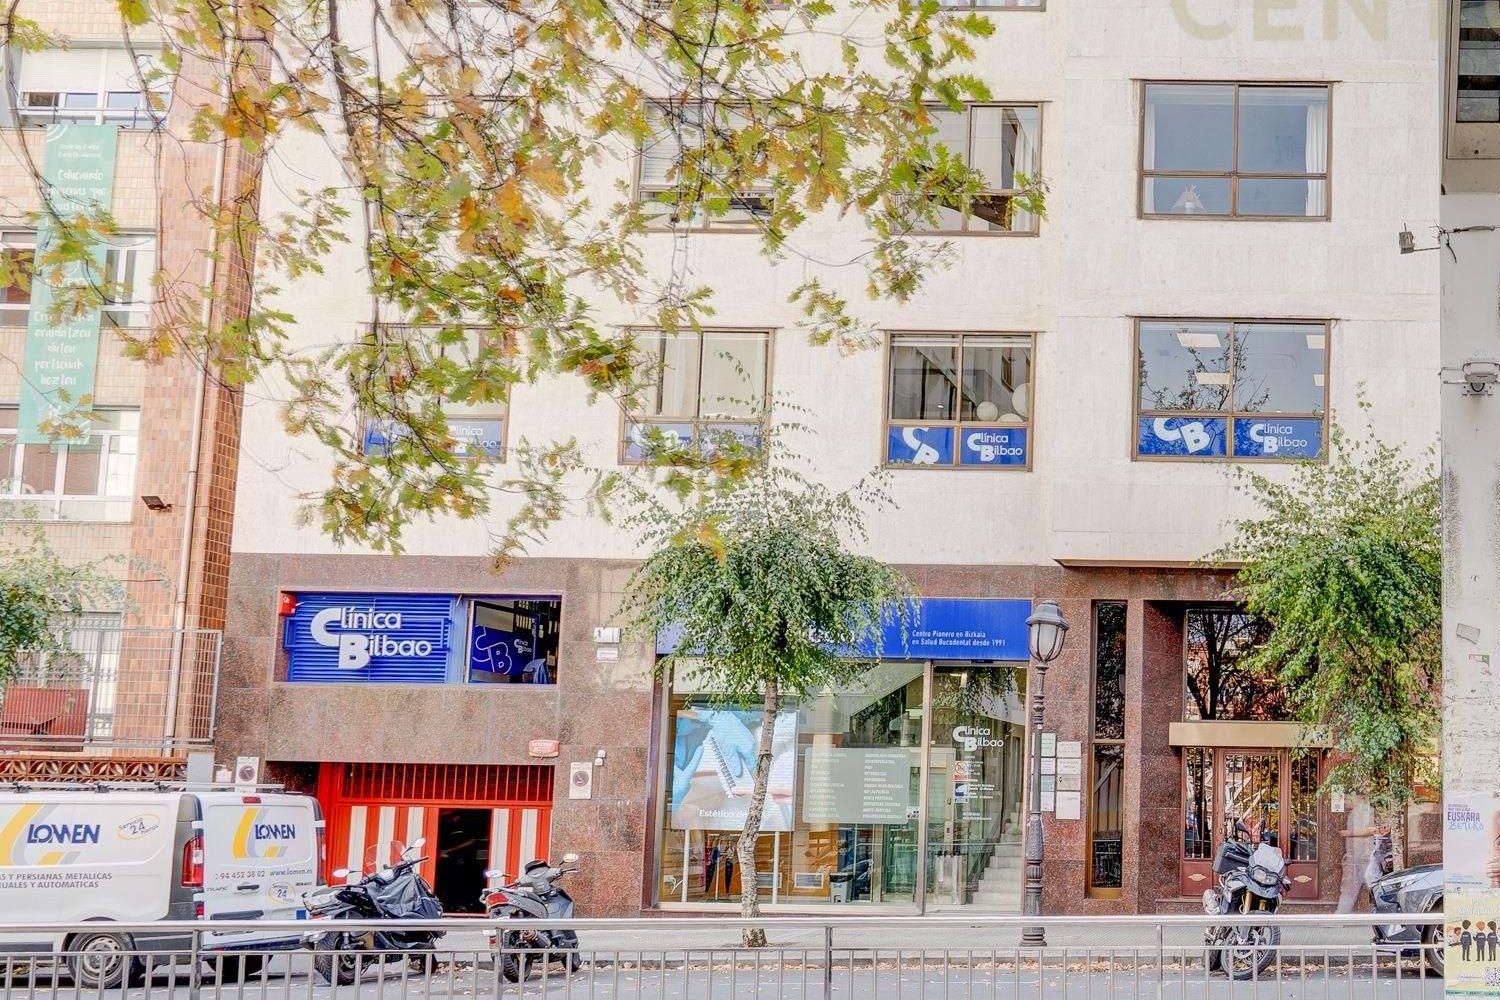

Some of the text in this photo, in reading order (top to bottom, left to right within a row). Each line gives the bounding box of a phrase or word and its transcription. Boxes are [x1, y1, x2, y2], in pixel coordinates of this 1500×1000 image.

[1249, 423, 1293, 443] Clínica
[966, 432, 1009, 451] Clínica
[1263, 436, 1308, 453] Bilbao
[980, 445, 1023, 462] Bilbao
[310, 607, 402, 648] Clínica
[912, 629, 931, 638] Centro
[932, 630, 955, 638] Pionero
[964, 630, 986, 638] Bizkaia
[920, 638, 938, 646] Salud
[938, 638, 972, 647] Bucodental
[972, 638, 990, 647] desde
[991, 639, 1006, 647] 1991
[338, 632, 433, 671] Bilbao
[952, 725, 991, 743] Clínica
[964, 736, 1004, 752] Bilbao
[1447, 811, 1480, 822] EUSKARA
[129, 820, 146, 835] 24
[8, 872, 14, 881] Y
[16, 872, 63, 881] PERSIANAS
[65, 872, 113, 881] METALICAS
[219, 871, 230, 880] 94
[231, 870, 245, 879] 452
[247, 869, 256, 878] 38
[30, 881, 36, 889] Y
[37, 880, 100, 889] AUTOMATICAS
[277, 888, 288, 899] 24
